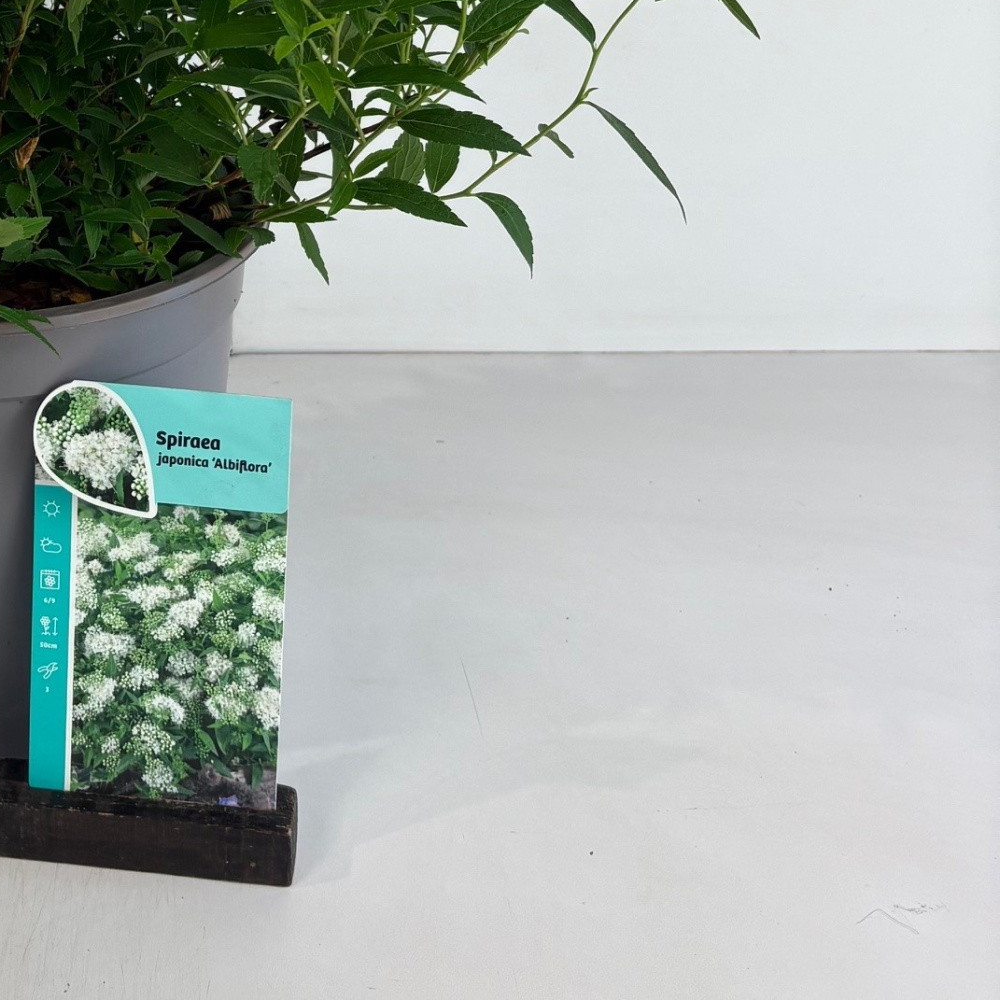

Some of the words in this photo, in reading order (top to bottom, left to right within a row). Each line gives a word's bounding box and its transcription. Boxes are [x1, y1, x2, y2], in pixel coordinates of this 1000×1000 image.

[156, 430, 221, 450] Spiraea
[156, 452, 209, 468] japonica
[40, 641, 58, 649] 50cm
